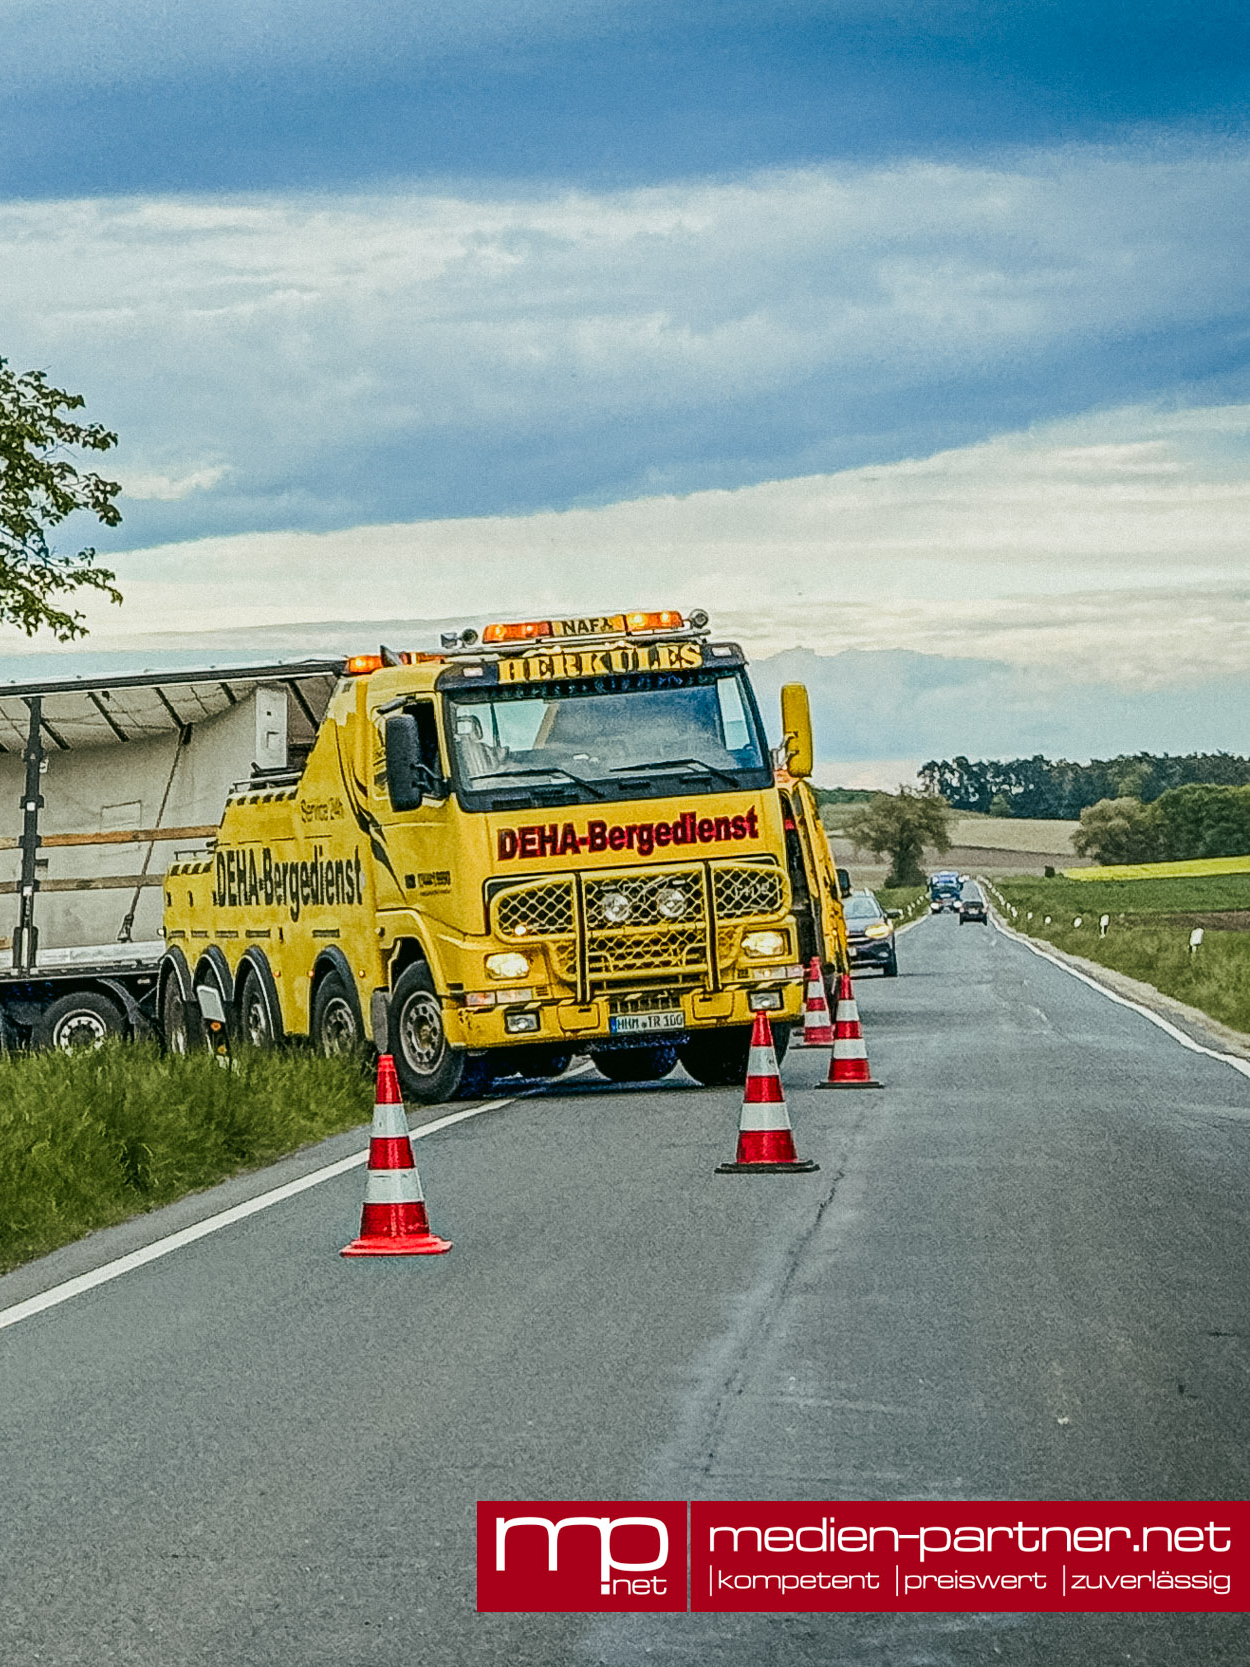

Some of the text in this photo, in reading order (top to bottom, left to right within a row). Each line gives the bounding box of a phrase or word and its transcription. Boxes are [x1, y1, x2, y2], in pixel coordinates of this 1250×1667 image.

[497, 643, 704, 685] HERKULES
[497, 805, 760, 861] DEHA-Bergedienst
[216, 844, 363, 923] DEHA-Bergedienst
